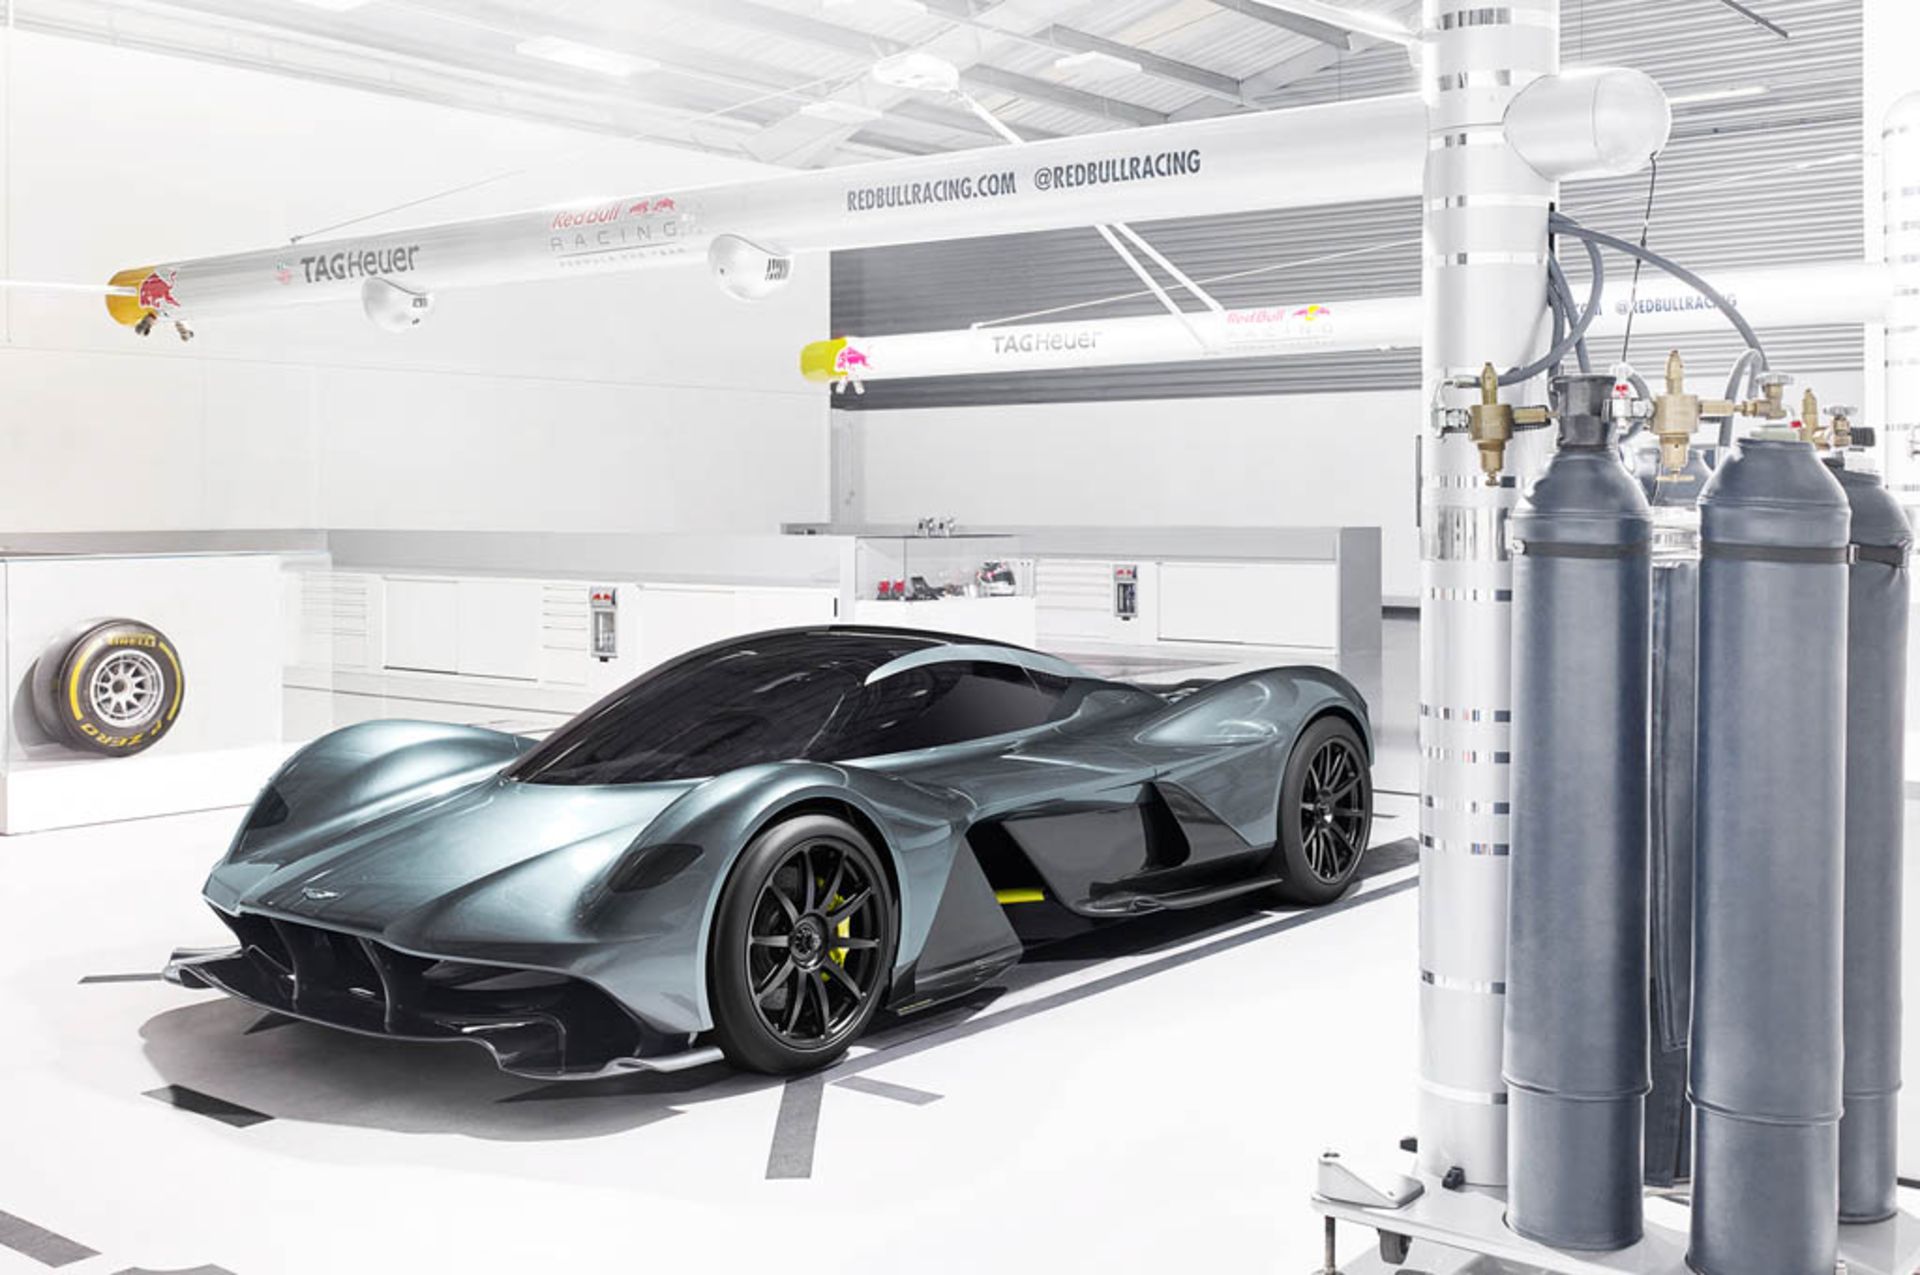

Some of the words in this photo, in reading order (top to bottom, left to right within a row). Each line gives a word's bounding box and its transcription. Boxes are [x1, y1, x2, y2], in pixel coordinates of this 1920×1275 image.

[847, 171, 1017, 212] REDBULLRACING.COM
[1034, 149, 1201, 191] @REDBULLRACING
[550, 221, 678, 252] RACING
